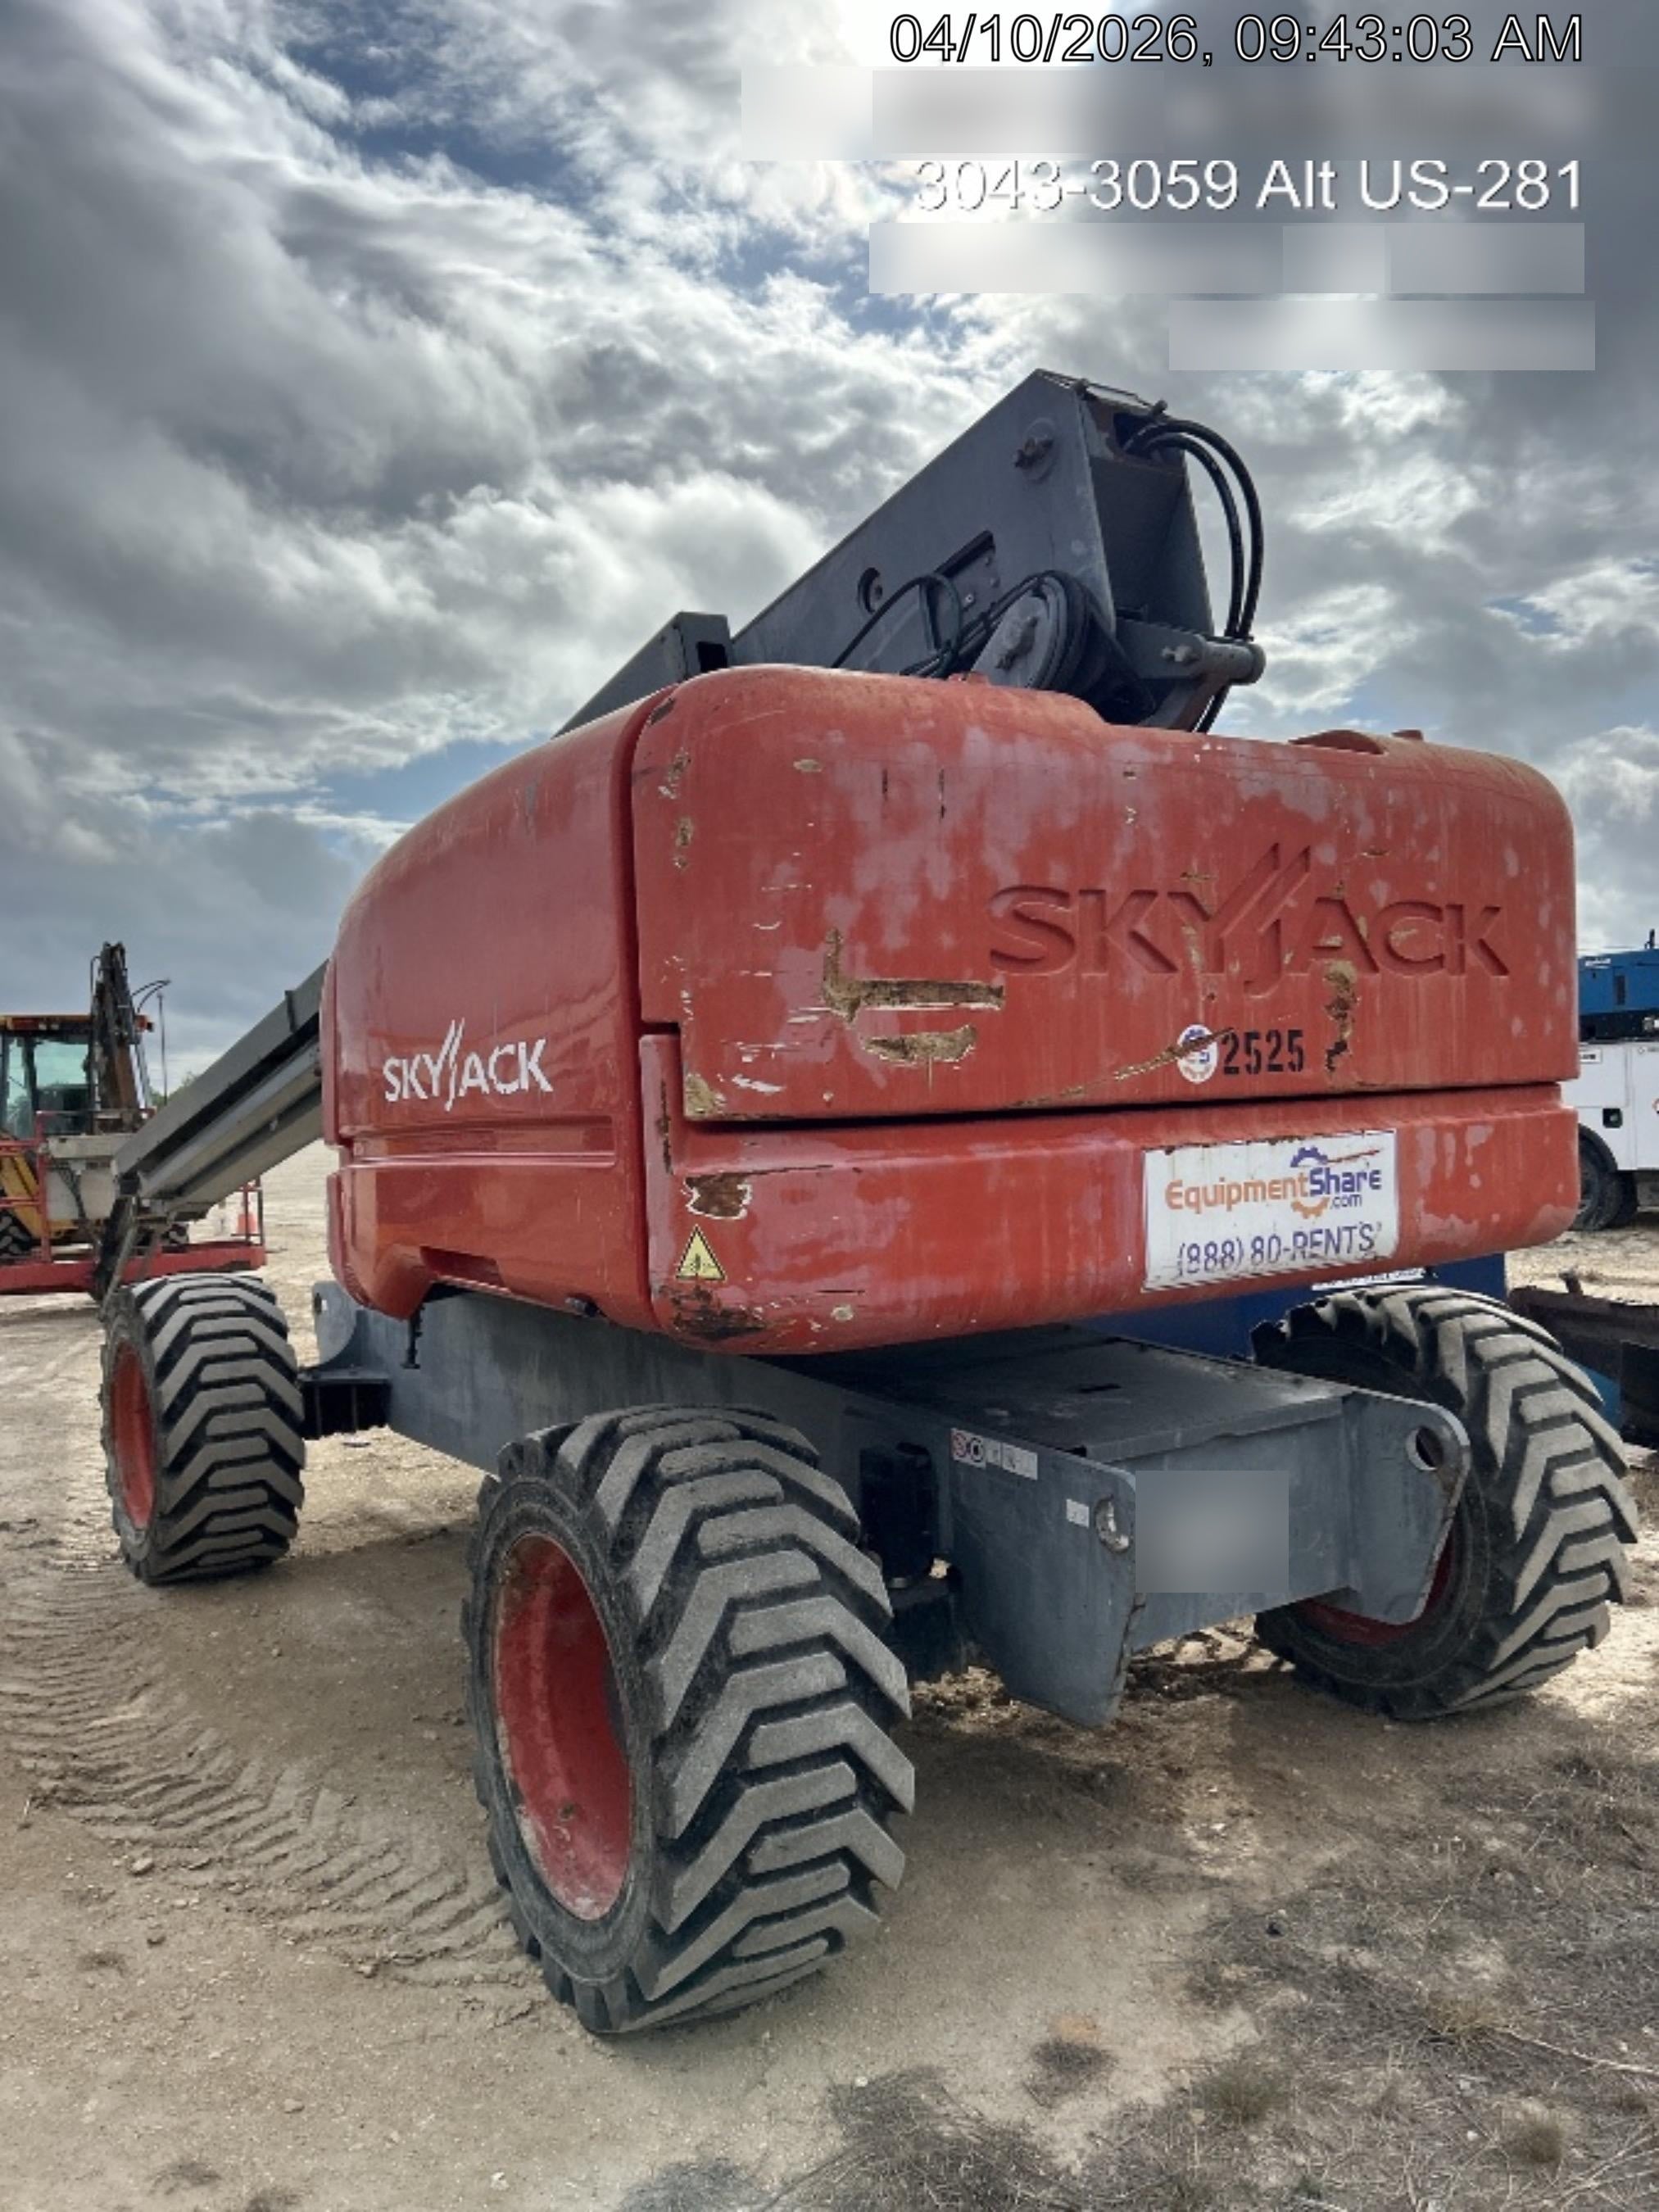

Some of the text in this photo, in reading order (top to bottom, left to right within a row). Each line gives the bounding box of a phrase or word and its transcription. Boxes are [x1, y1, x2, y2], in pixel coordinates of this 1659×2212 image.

[988, 842, 1511, 999] SKYJACK
[383, 1018, 553, 1112] SKYJACK
[1222, 1029, 1303, 1075] 2525
[1165, 1167, 1382, 1214] EquipmentShare
[1330, 1194, 1363, 1210] .com
[1178, 1237, 1244, 1276] (888)
